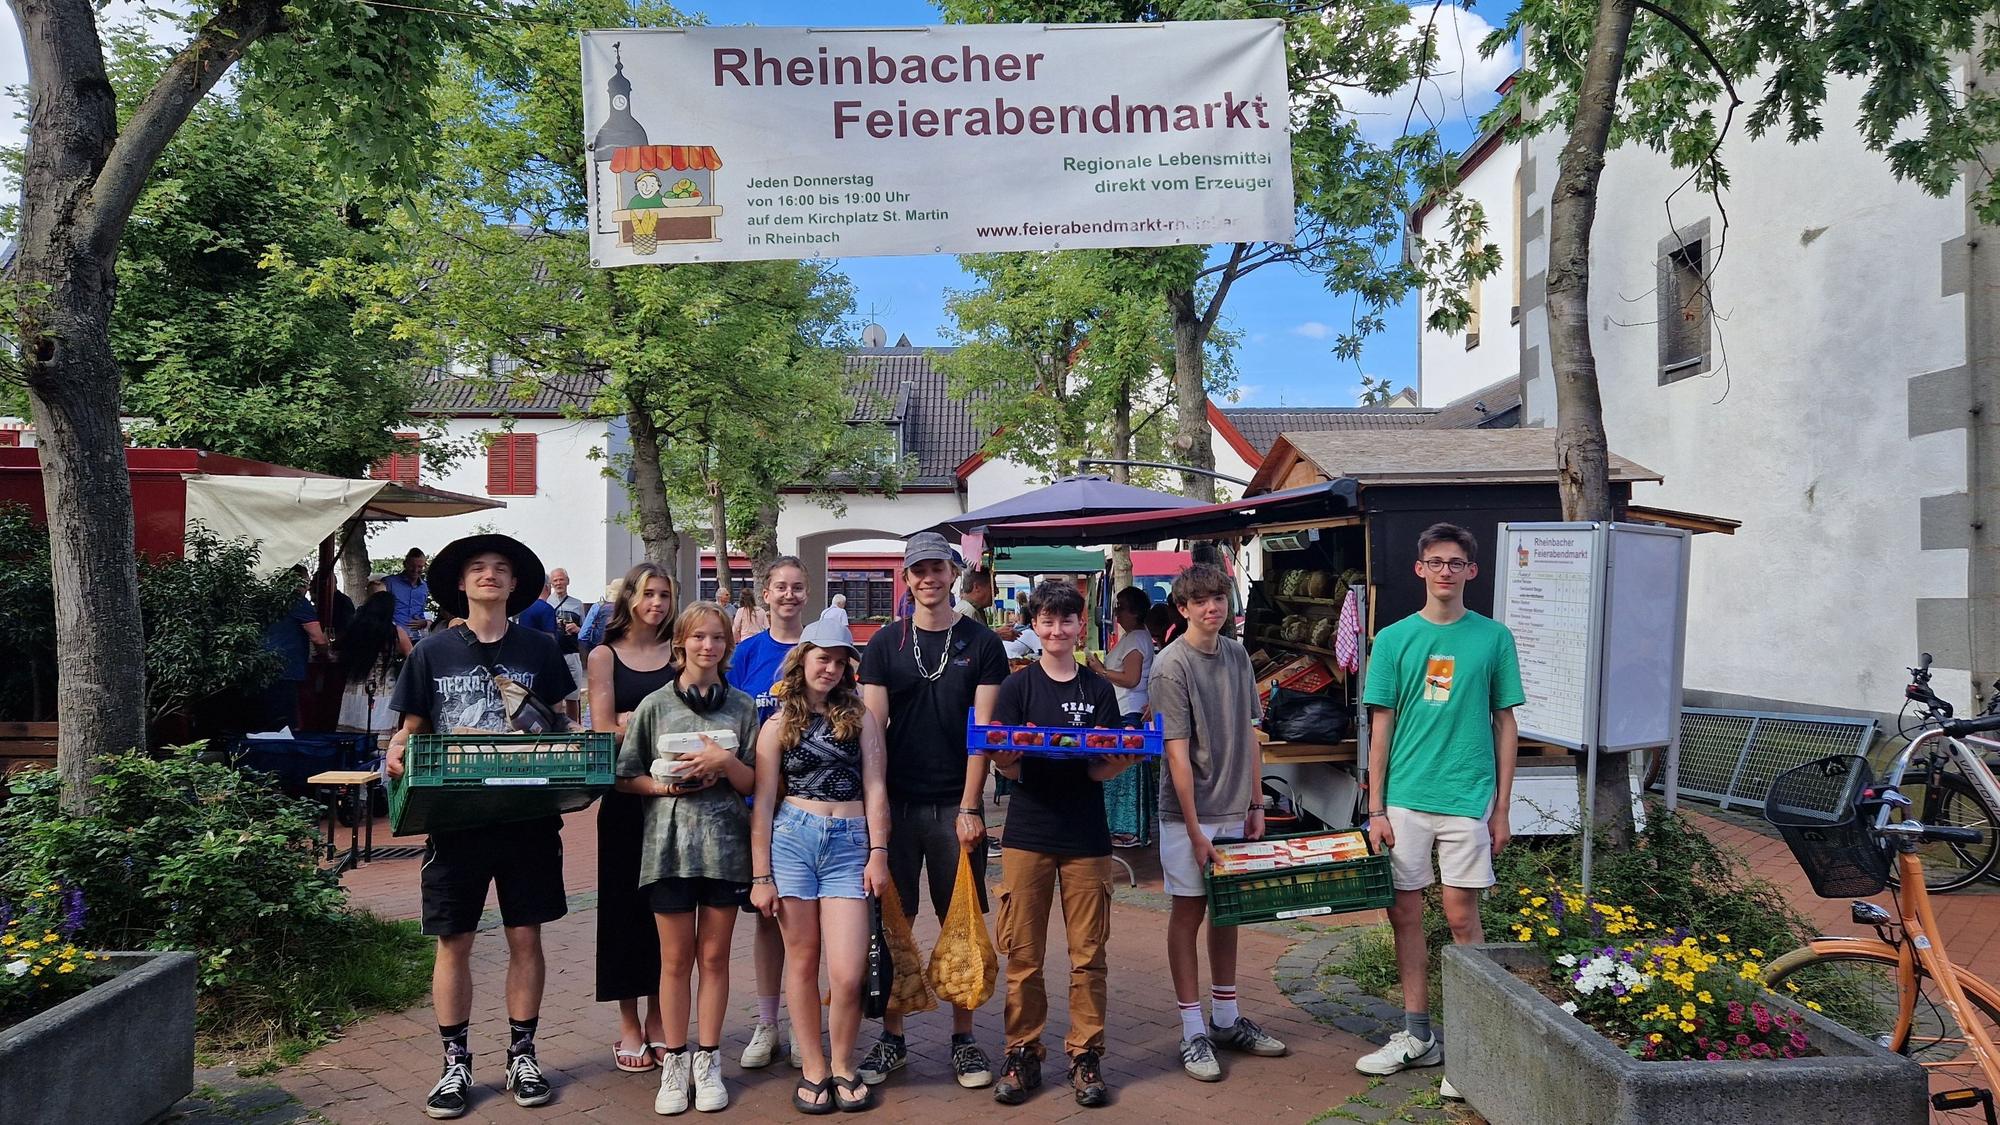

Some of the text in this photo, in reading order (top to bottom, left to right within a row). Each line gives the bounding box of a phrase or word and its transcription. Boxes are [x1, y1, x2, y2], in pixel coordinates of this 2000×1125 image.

[713, 45, 1045, 87] Rheinbacher
[833, 91, 1271, 140] Feierabendmarkt
[1063, 153, 1152, 174] Regionale
[746, 173, 874, 190] Jeden Donnerstag
[1094, 175, 1274, 194] direkt vom Erzeuger
[747, 190, 911, 207] von 16:00 bis 19:00 Uhr
[747, 208, 949, 228] auf dem Kirchplatz St. Martin
[748, 230, 840, 245] in Rheinbach
[1534, 537, 1575, 547] Rheinbacher
[1534, 549, 1588, 559] Feierabendmarkt
[1061, 701, 1095, 714] TEAM
